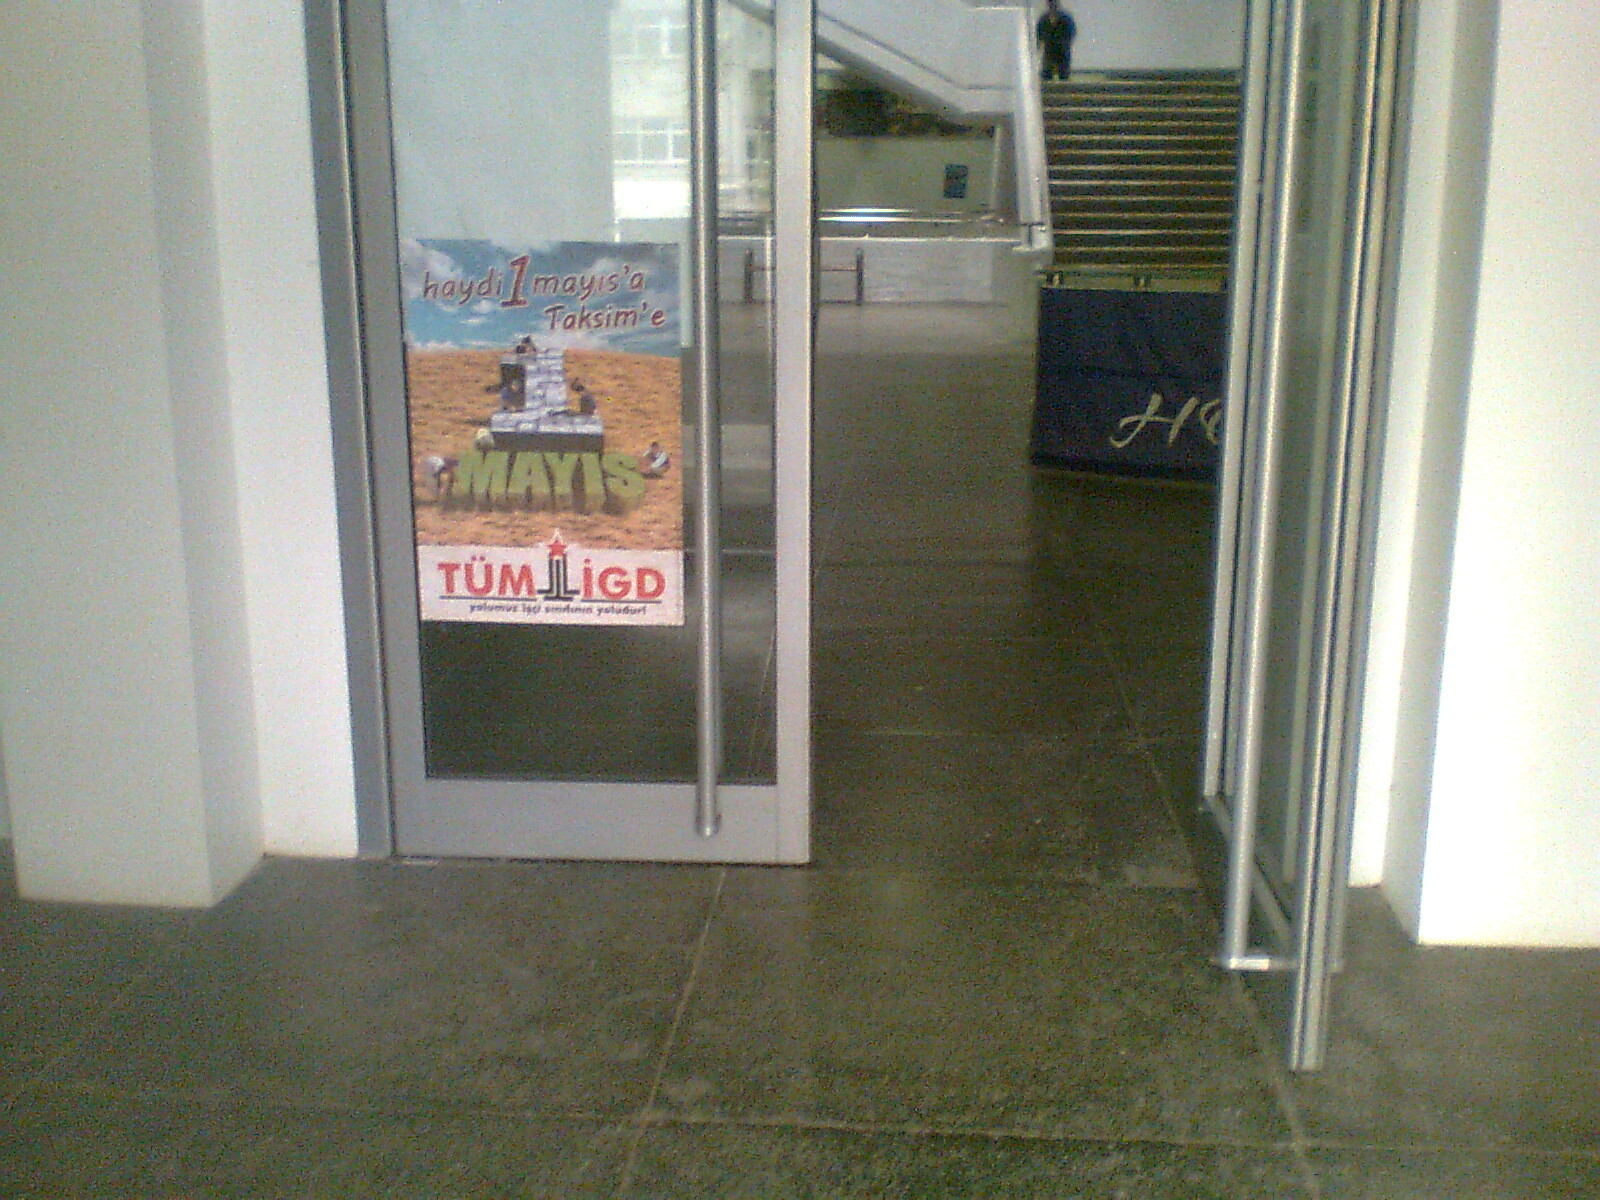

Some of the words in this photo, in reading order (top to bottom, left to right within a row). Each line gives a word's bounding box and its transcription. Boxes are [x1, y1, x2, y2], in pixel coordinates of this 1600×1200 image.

[423, 267, 504, 304] haydi
[501, 254, 530, 309] 1
[544, 301, 666, 330] Taksim'e
[449, 450, 646, 507] MAYIS
[437, 555, 536, 597] TÜM
[582, 558, 667, 600] İGD
